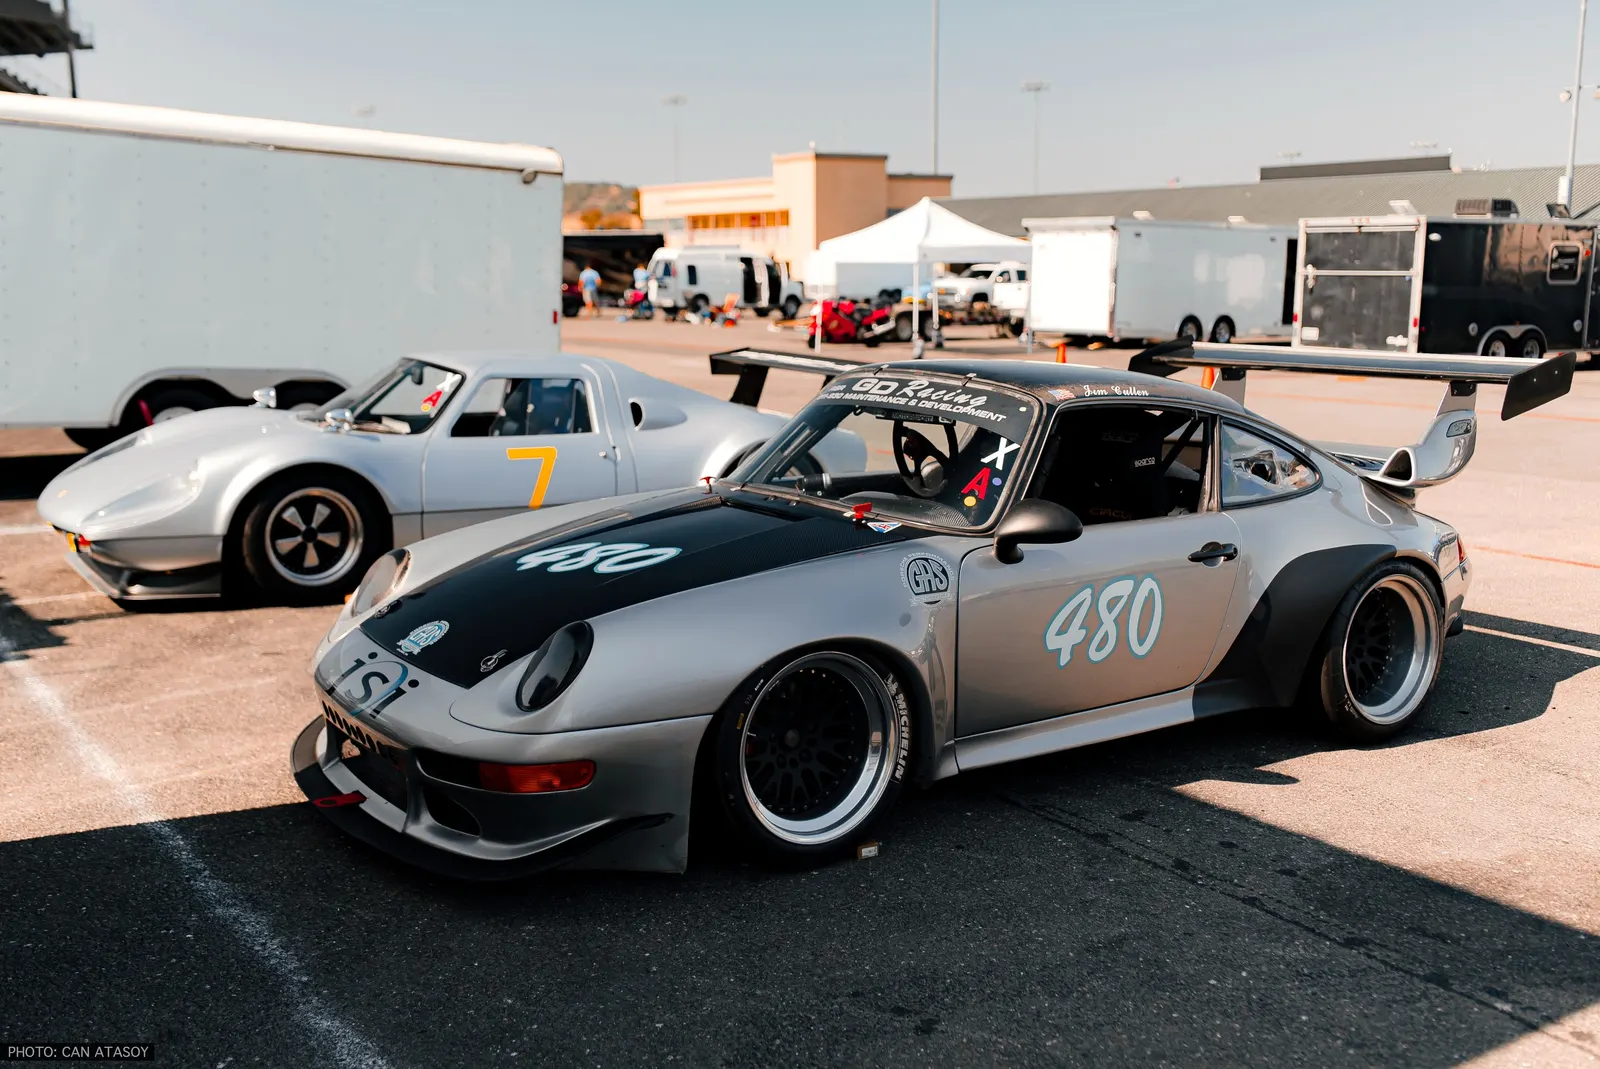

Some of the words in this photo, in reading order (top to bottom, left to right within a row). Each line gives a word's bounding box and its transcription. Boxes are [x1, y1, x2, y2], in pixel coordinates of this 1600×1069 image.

[421, 389, 444, 408] A
[843, 393, 909, 406] MAINTENANCE
[908, 399, 917, 407] &
[917, 400, 1007, 423] DEVELOPMENT
[852, 378, 899, 394] GD
[896, 380, 988, 410] Racing
[980, 436, 1021, 471] X
[505, 446, 558, 511] 7
[961, 467, 991, 500] A
[516, 542, 683, 573] 480
[908, 559, 948, 594] GAS
[1043, 573, 1165, 670] 480
[894, 692, 910, 782] MICHELIN
